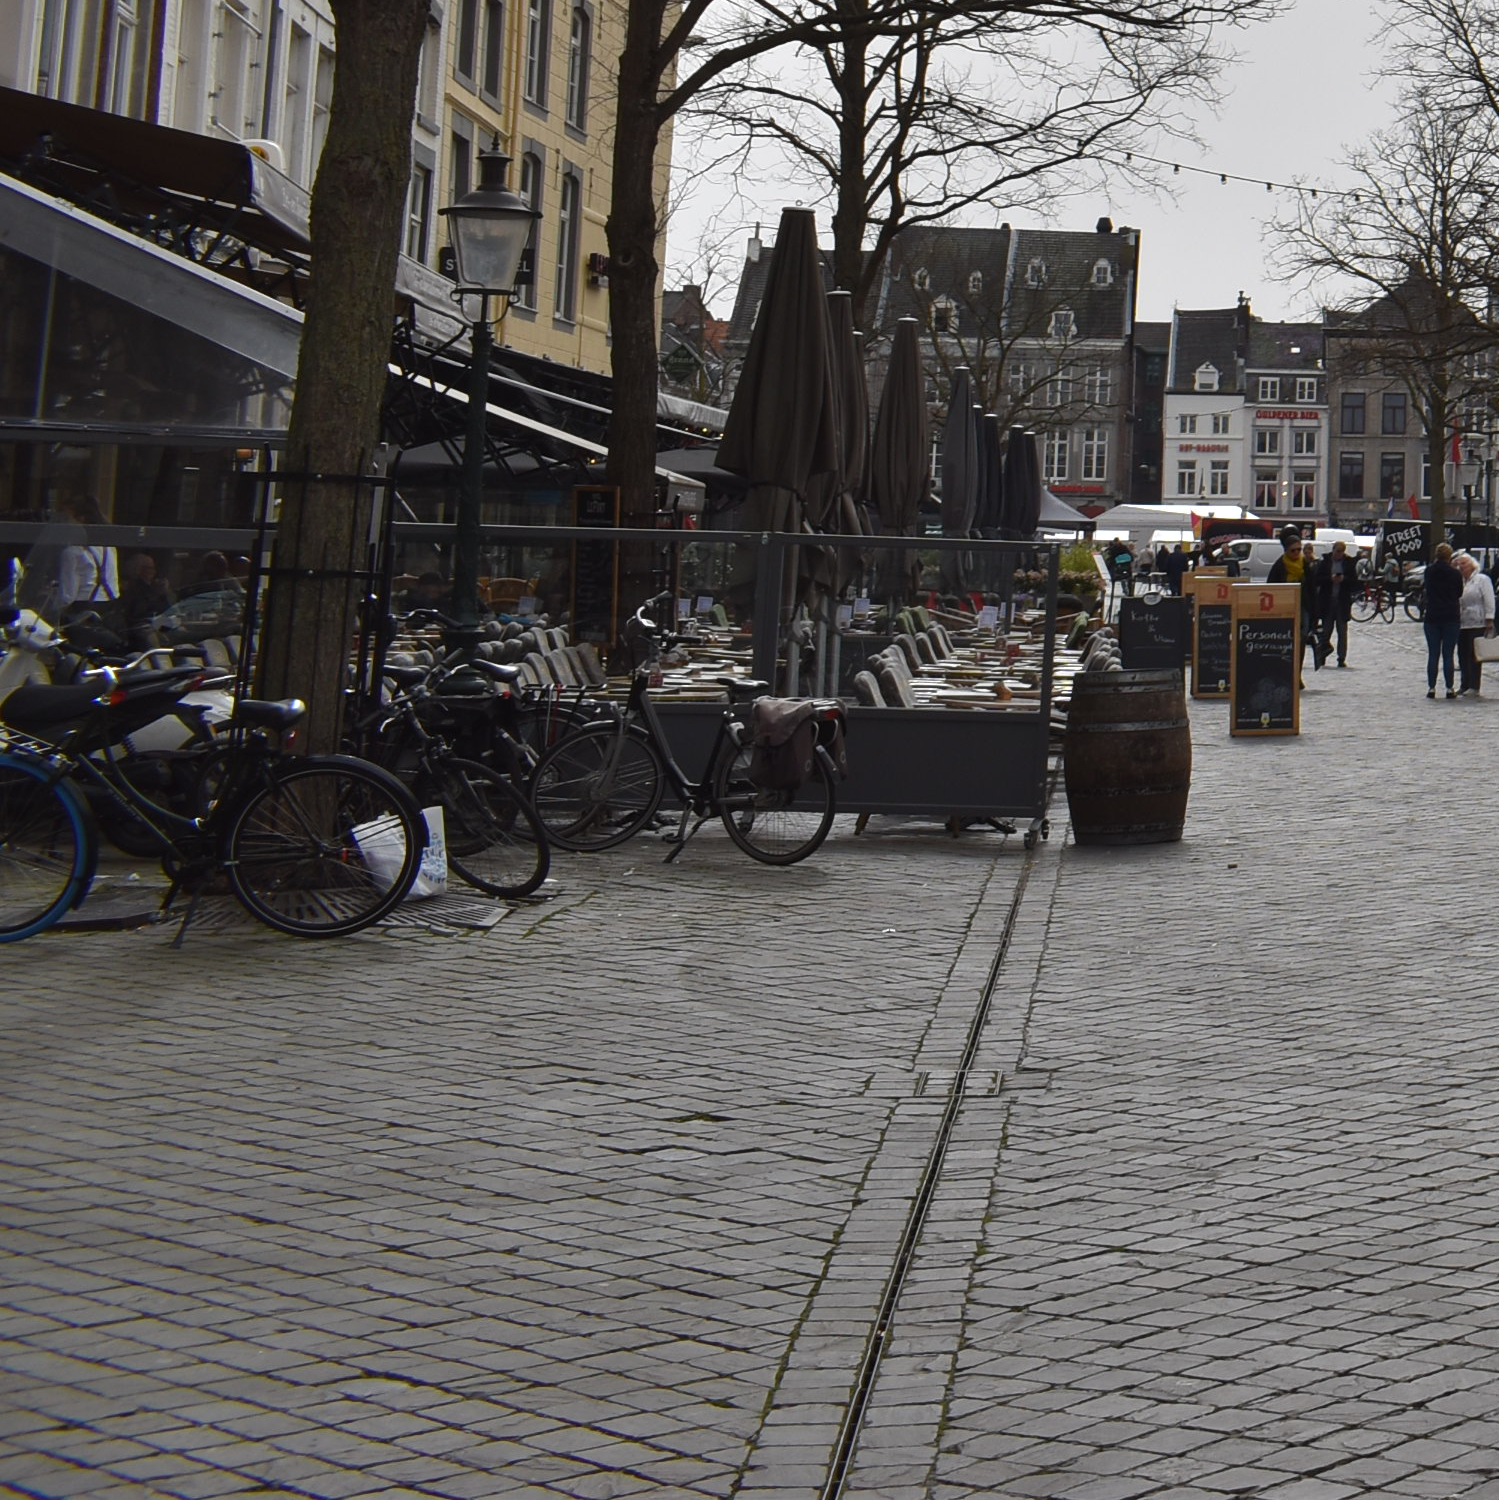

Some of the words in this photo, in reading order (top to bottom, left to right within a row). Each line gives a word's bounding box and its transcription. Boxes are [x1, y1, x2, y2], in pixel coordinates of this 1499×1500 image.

[1300, 411, 1319, 420] BIER
[1386, 524, 1423, 546] STREET
[1394, 539, 1423, 557] FOOD
[1239, 624, 1293, 640] Personeel
[1246, 641, 1293, 653] gevraagd
